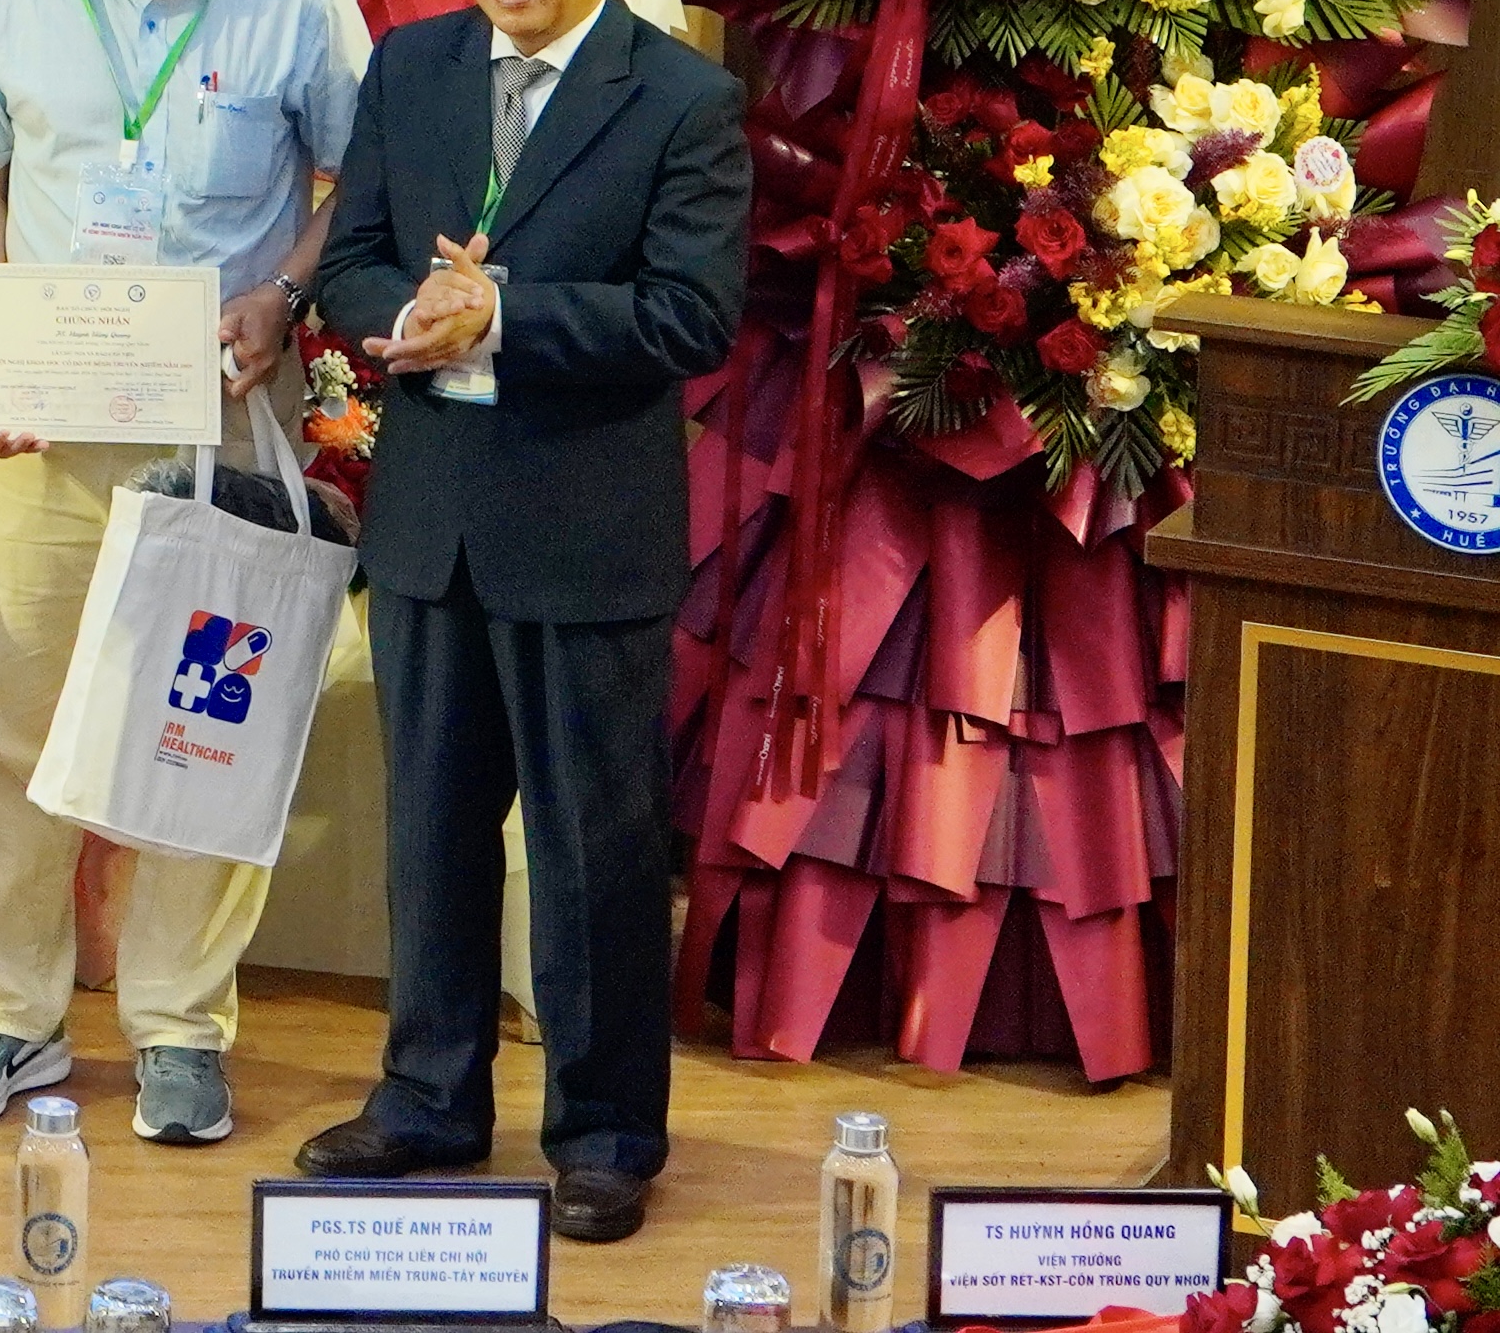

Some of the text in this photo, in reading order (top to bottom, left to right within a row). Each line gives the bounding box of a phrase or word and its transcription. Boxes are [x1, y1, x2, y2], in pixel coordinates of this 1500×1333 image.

[1385, 382, 1471, 486] TRƯỜNG ĐẠI
[1449, 510, 1488, 524] 1957
[1443, 530, 1486, 547] HUẾ
[167, 722, 185, 737] RM
[162, 736, 235, 765] HEALTHCARE
[311, 1216, 492, 1236] PGS.TS QUẾ ANH TRÂM
[985, 1220, 1175, 1240] TS HUỲNH HỒNG QUANG
[315, 1248, 487, 1265] PHÓ CHỦ TỊCH LIÊN CHI HỘI
